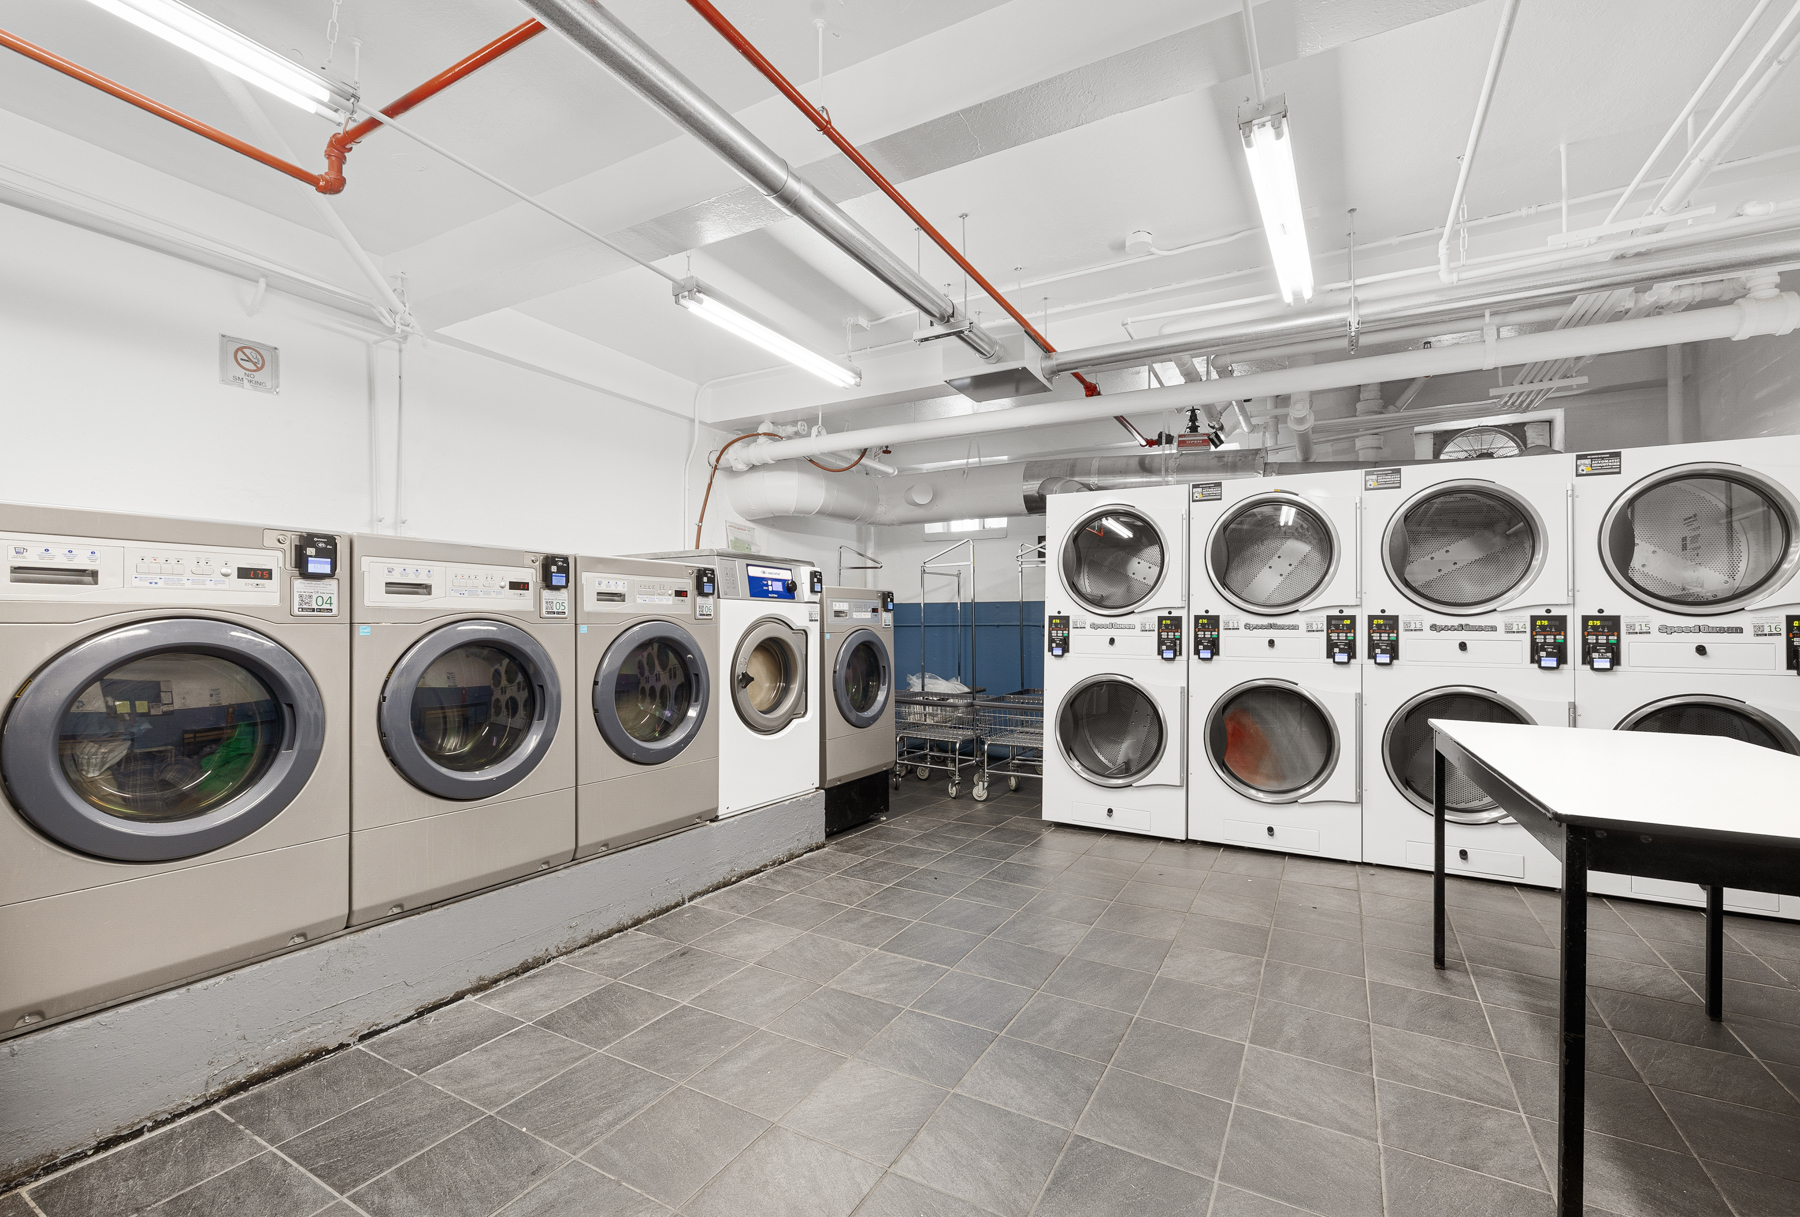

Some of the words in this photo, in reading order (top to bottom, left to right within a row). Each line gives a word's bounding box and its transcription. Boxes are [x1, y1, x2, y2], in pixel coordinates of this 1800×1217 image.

[315, 595, 333, 607] 04
[555, 601, 566, 611] 05
[704, 605, 712, 614] 06
[1090, 622, 1112, 630] Speed
[1430, 623, 1463, 632] Speed
[1639, 623, 1651, 631] 15
[1658, 624, 1700, 635] Speed
[1700, 624, 1744, 634] Queen
[1767, 624, 1782, 633] 16
